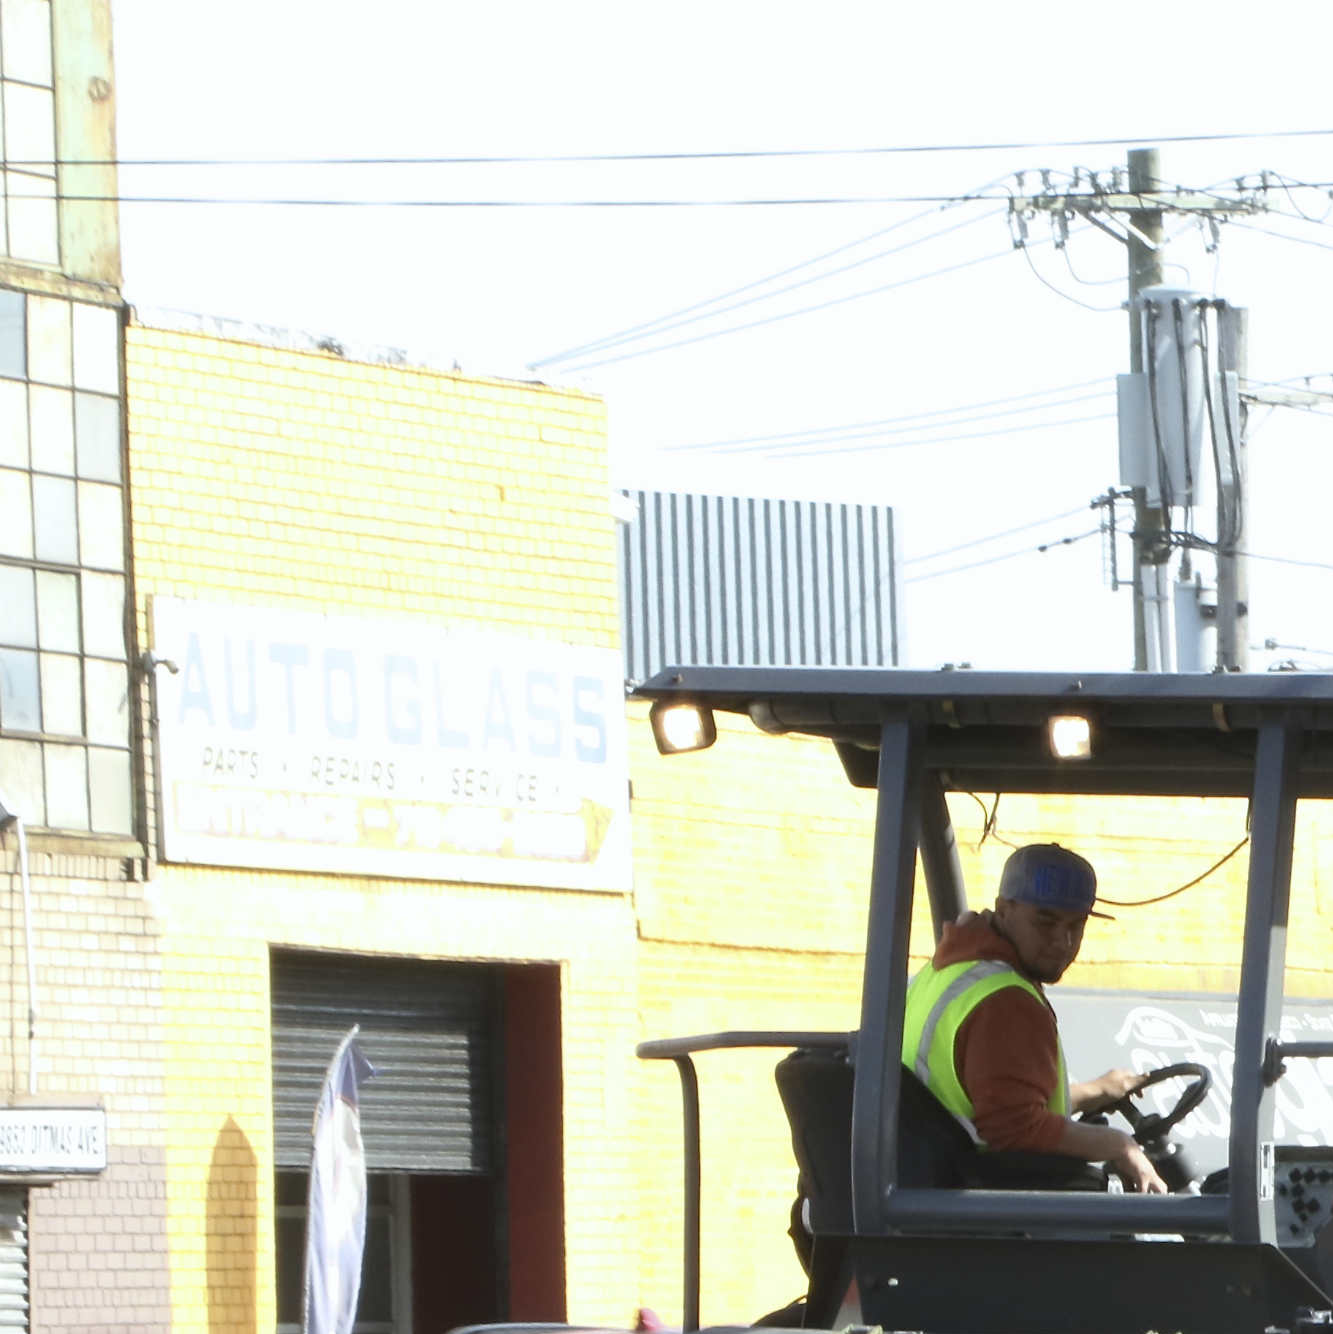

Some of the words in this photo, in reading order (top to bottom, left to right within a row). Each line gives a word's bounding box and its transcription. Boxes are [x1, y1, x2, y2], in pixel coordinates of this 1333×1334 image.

[176, 632, 359, 741] AUTO
[383, 652, 608, 765] GLASS
[201, 746, 260, 780] PARTS
[311, 754, 397, 792] REPAIRS
[450, 768, 538, 804] SERVCE
